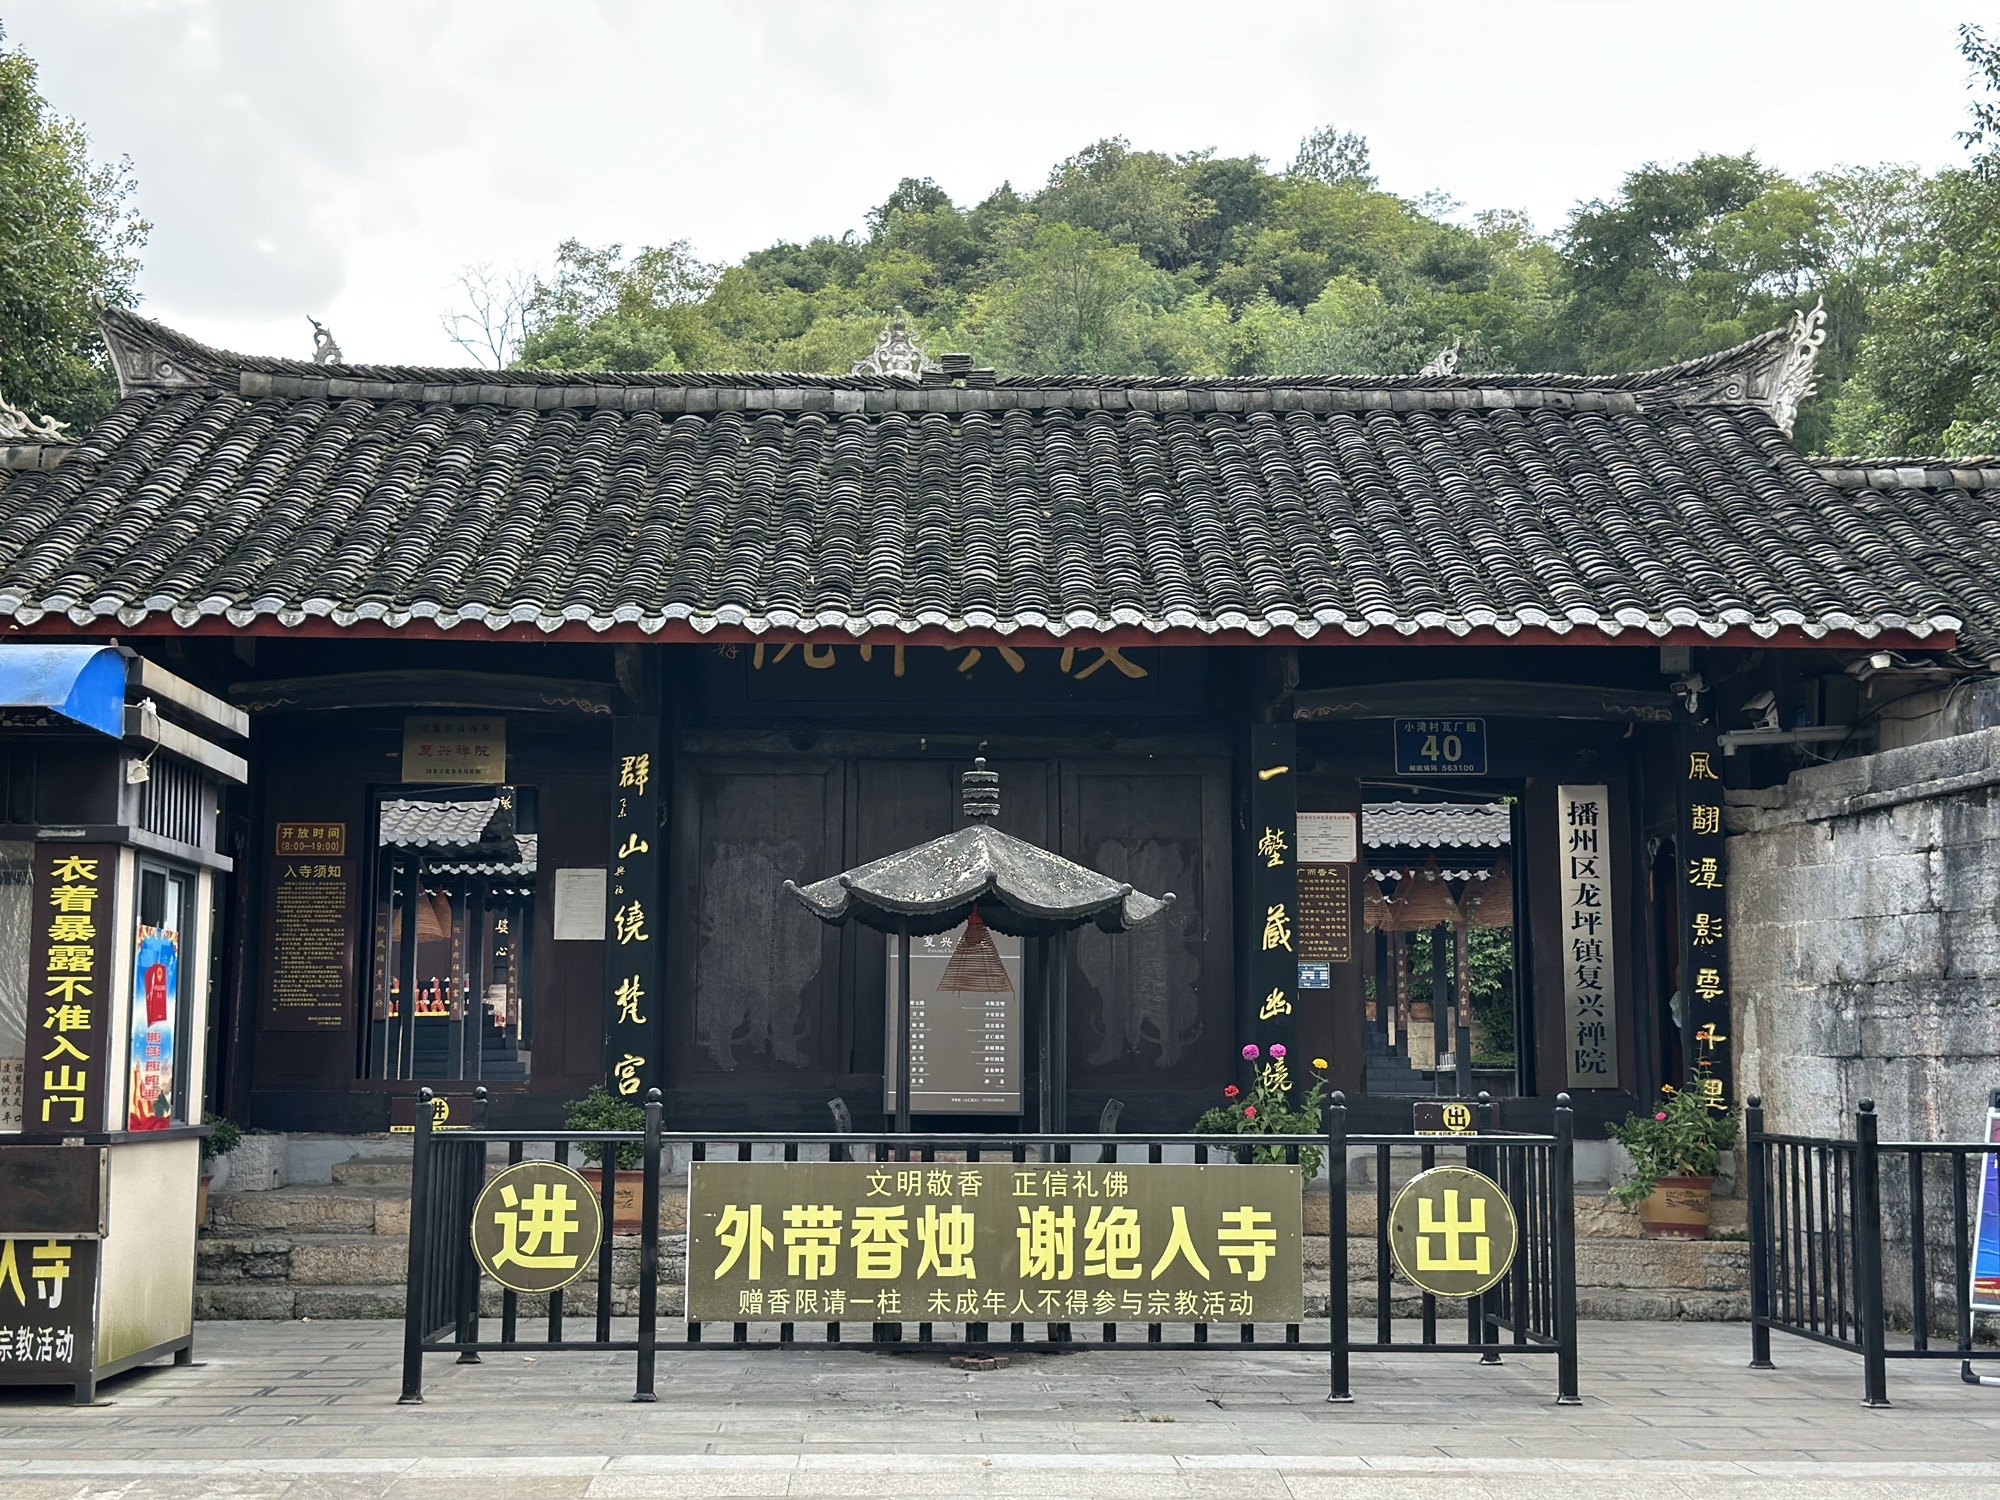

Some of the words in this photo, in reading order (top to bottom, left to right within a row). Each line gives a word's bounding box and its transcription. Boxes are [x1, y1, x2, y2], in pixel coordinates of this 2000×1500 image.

[1404, 721, 1477, 732] 小湾村瓦厂组
[1420, 735, 1462, 762] 40
[282, 827, 340, 839] 开放时间
[284, 864, 341, 878] 入寺须知
[1567, 800, 1608, 1075] 播州区龙坪镇复兴禅院
[41, 855, 99, 1123] 衣着暴露不准入山门
[1448, 1107, 1466, 1127] 出
[866, 1170, 983, 1198] 文明敬香
[1012, 1170, 1129, 1198] 正信礼佛
[491, 1183, 579, 1270] 进
[1416, 1189, 1490, 1275] 出
[714, 1203, 977, 1281] 外带香烛
[1016, 1204, 1279, 1282] 谢绝入寺
[738, 1289, 902, 1317] 赠香限请一柱
[927, 1289, 1254, 1317] 未成年人不得参与宗教活动
